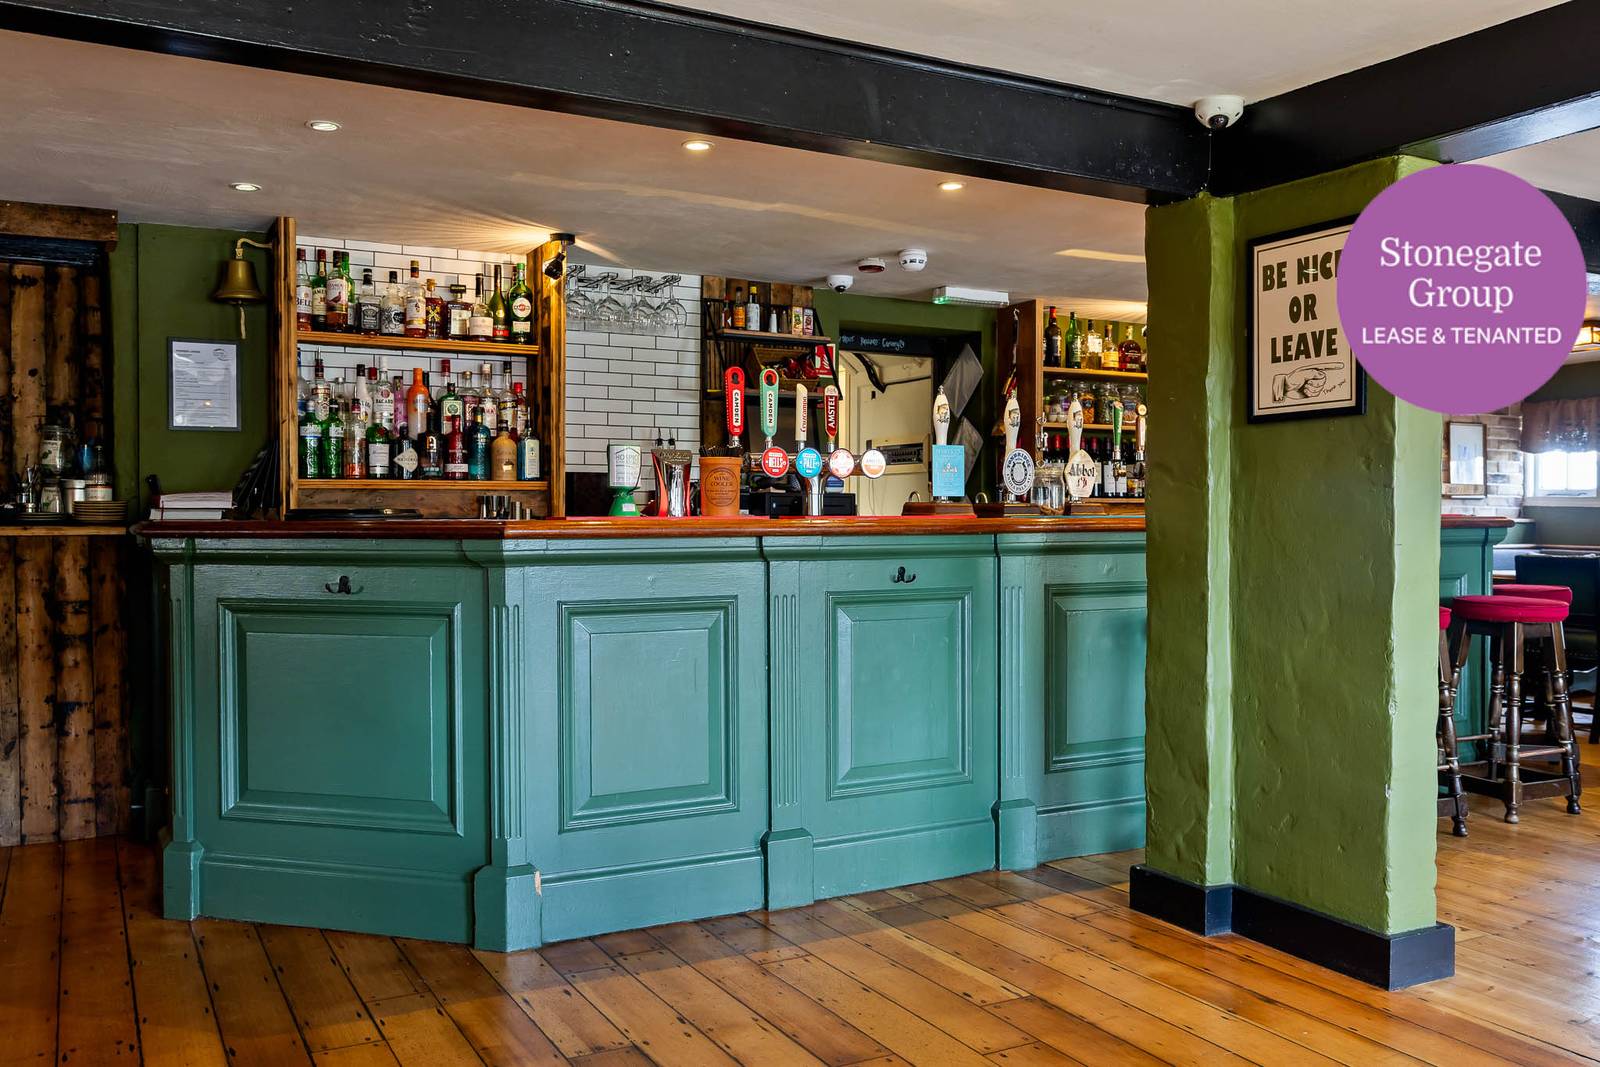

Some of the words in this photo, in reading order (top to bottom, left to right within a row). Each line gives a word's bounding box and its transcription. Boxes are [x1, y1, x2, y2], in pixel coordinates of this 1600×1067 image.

[1262, 261, 1288, 292] BE
[1289, 293, 1318, 324] OR
[1271, 328, 1338, 364] LEAVE
[827, 395, 836, 428] AMSTEL
[1069, 463, 1096, 477] Abbot
